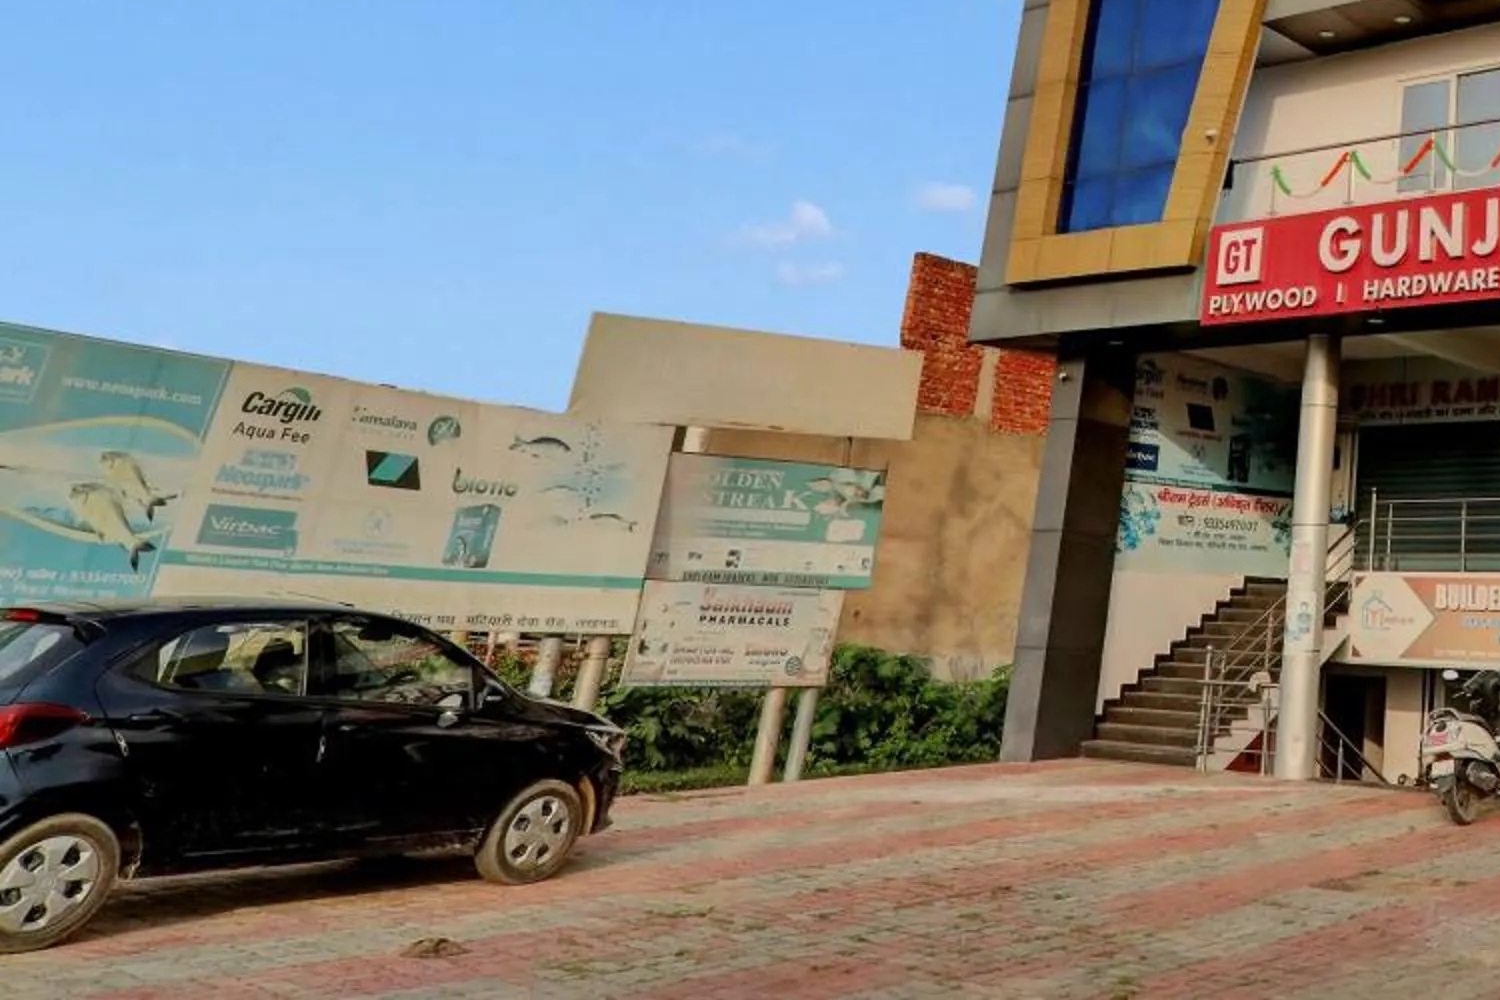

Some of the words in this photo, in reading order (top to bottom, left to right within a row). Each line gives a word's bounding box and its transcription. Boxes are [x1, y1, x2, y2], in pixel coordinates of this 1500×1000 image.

[1222, 238, 1259, 277] GT
[1208, 285, 1318, 317] PLYWOOD
[232, 421, 275, 441] Aqua
